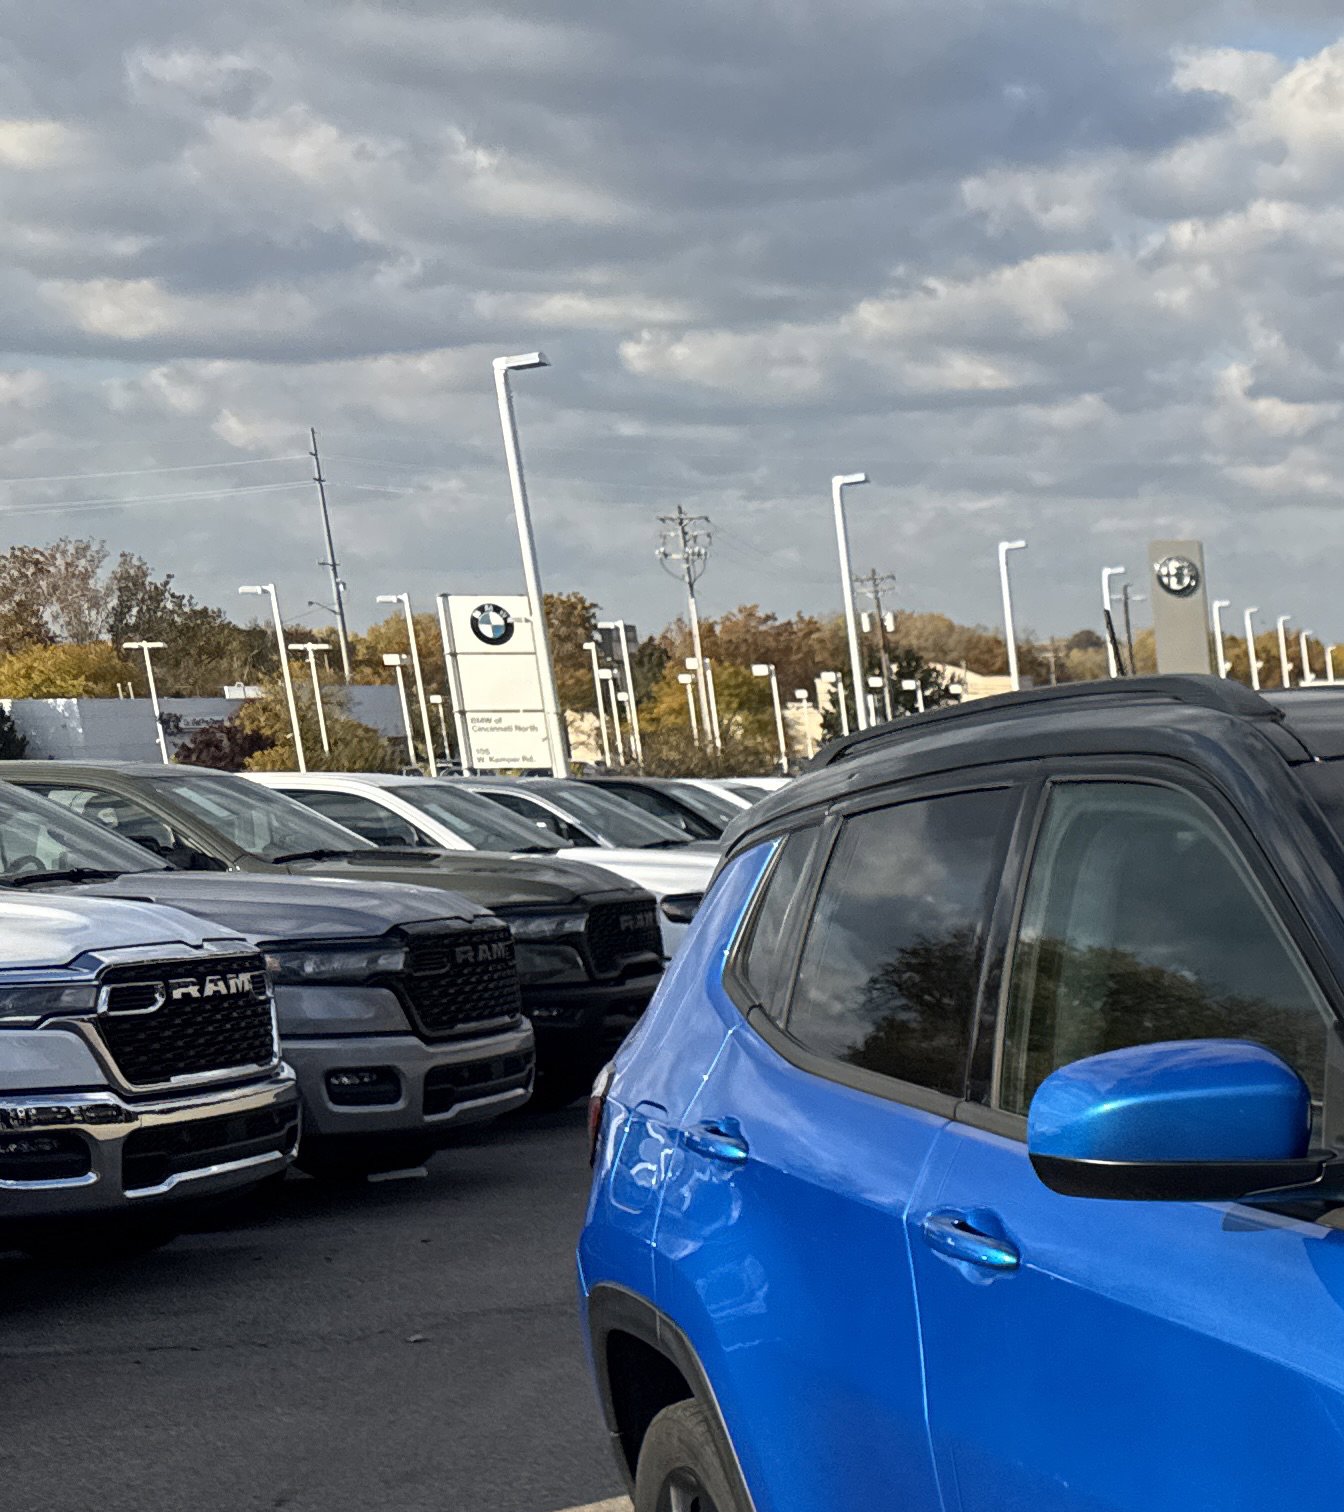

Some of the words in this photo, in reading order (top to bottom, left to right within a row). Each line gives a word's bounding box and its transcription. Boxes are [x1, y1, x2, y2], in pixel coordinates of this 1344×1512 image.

[514, 724, 539, 732] North
[455, 942, 506, 963] RAM
[168, 973, 253, 1000] RAM
